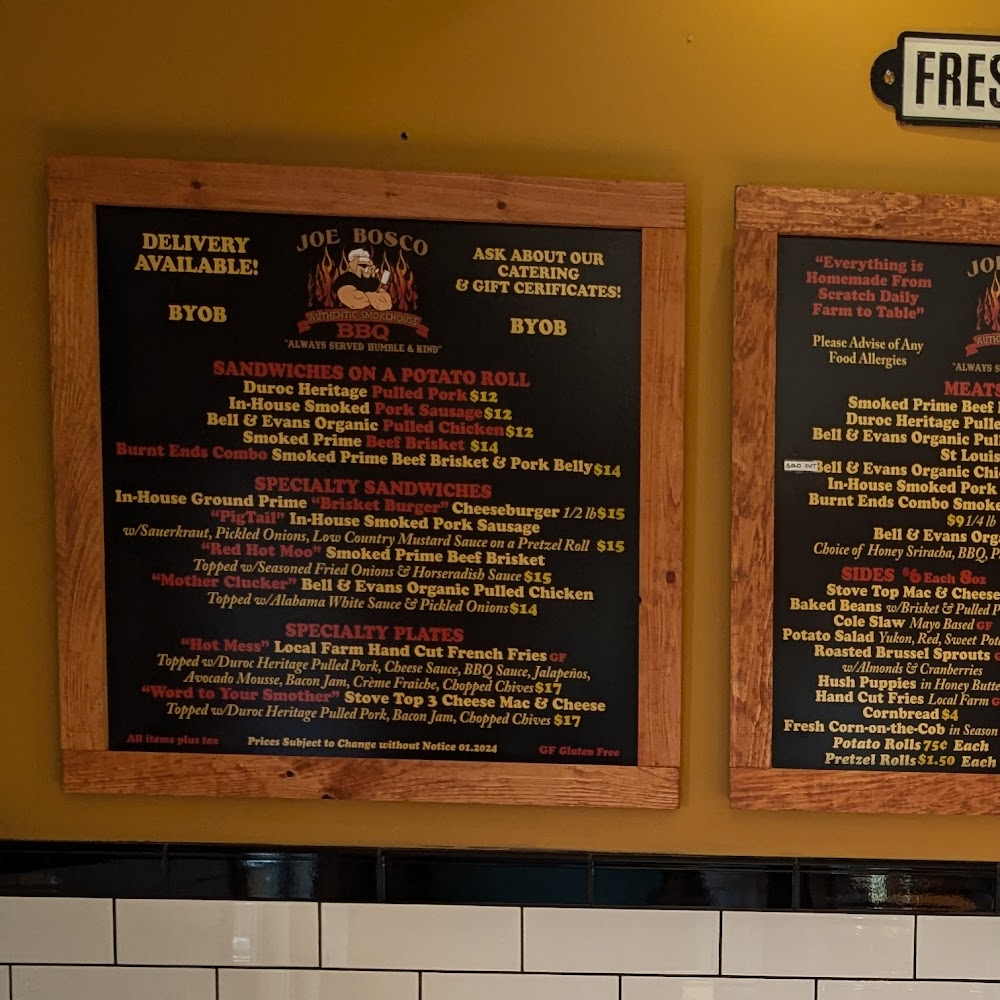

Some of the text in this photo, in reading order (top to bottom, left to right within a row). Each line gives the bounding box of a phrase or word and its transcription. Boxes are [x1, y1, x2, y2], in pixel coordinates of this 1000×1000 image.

[143, 233, 250, 253] DELIVERY
[296, 228, 429, 256] JOE BOSCO
[134, 254, 258, 275] AVAILABLE!
[473, 248, 604, 265] ASK ABOUT OUR
[498, 265, 580, 280] CATERING
[911, 260, 923, 272] is
[456, 279, 621, 298] & GIFT CERIFICATES!
[806, 271, 931, 288] Homemade From
[818, 287, 919, 305] Scratch Daily
[169, 305, 227, 322] BYOB
[813, 303, 852, 316] Farm
[857, 306, 872, 317] to
[337, 323, 389, 341] BBQ
[511, 318, 567, 336] BYOB
[214, 361, 530, 387] SANDWICHES ON A POTATO ROLL
[243, 430, 498, 454] Smoked Prime Beef Brisket $14
[255, 477, 492, 499] SPECIALTY SANDWICHES
[809, 493, 854, 506] Burnt
[858, 494, 894, 508] Ends
[898, 496, 949, 509] Combo
[286, 623, 464, 642] SPECIALTY PLATES
[167, 702, 581, 728] Topped w/Duroc Heritage Pulled Pork, Bacon Jam, Chopped Chives $17
[248, 737, 497, 753] Prices Subject to Change without Notice 01.2024
[539, 746, 620, 756] GF Gluten Free
